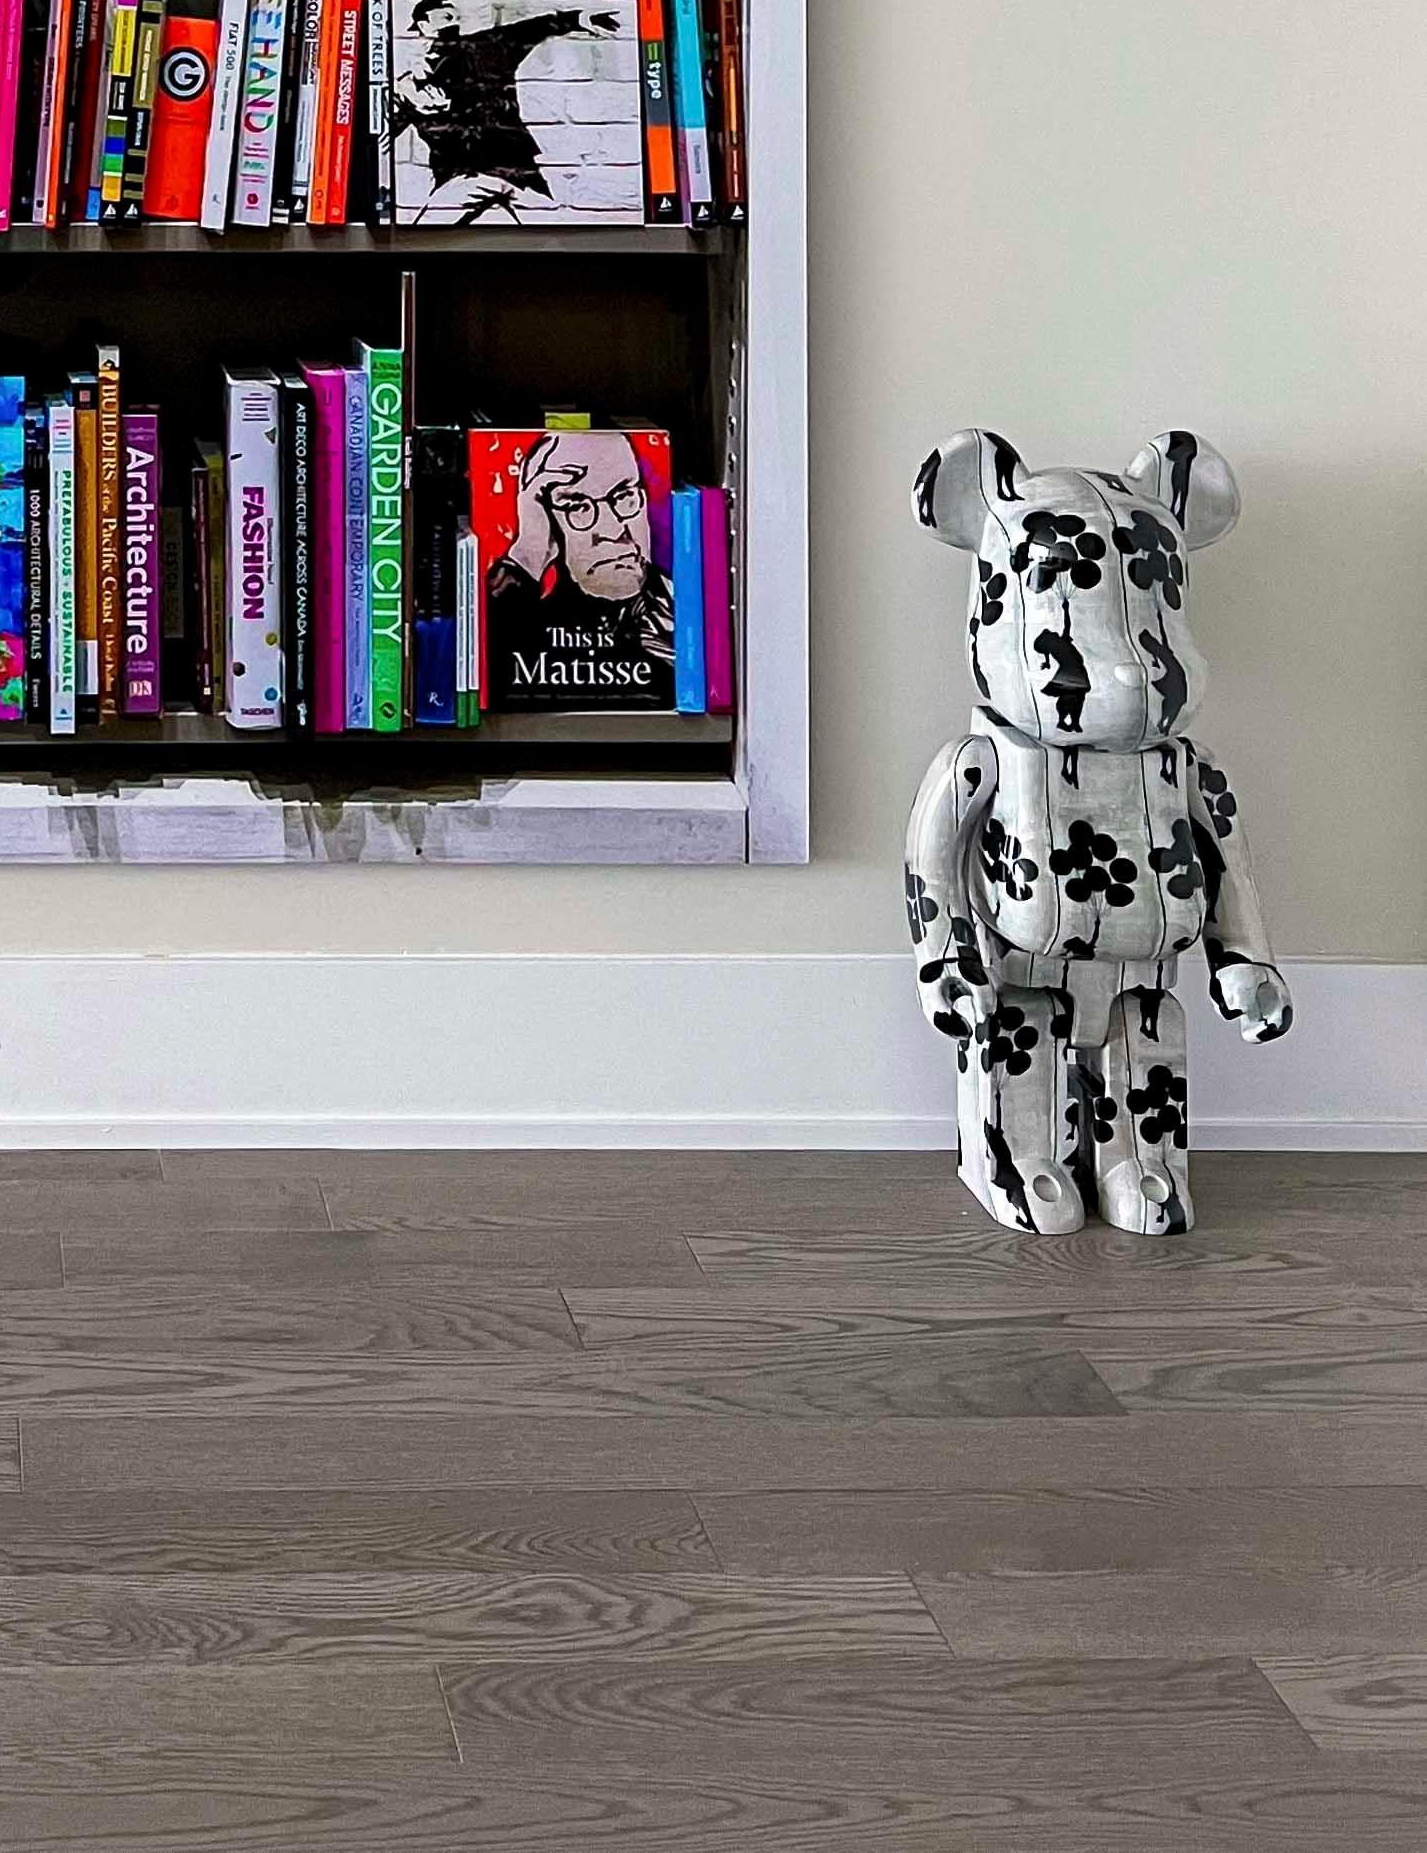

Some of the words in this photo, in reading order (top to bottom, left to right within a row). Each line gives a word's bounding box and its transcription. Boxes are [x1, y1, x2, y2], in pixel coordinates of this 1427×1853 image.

[227, 22, 239, 47] FIAT
[341, 9, 358, 56] STREET
[372, 11, 383, 29] OF
[225, 49, 237, 71] 500
[371, 35, 384, 76] TREES
[646, 61, 663, 100] type
[336, 59, 355, 125] MESSAGES
[101, 384, 118, 482] BUILDERS
[348, 395, 363, 471] CANADIAN
[371, 382, 402, 546] GARDEN
[29, 488, 41, 517] 1000
[61, 470, 72, 577] PREFABULOUS
[30, 520, 42, 608] ARCHITECTURAL
[101, 517, 117, 572] Pacific
[125, 447, 155, 654] Architecture
[242, 486, 266, 620] FASHION
[349, 476, 364, 602] CONTEMPORARY
[102, 576, 117, 625] Coast
[371, 558, 402, 645] CITY
[30, 613, 42, 660] DETAILS
[61, 590, 73, 693] SUSTAINABLE
[546, 625, 589, 648] This
[594, 625, 615, 648] is
[512, 650, 652, 686] Matisse
